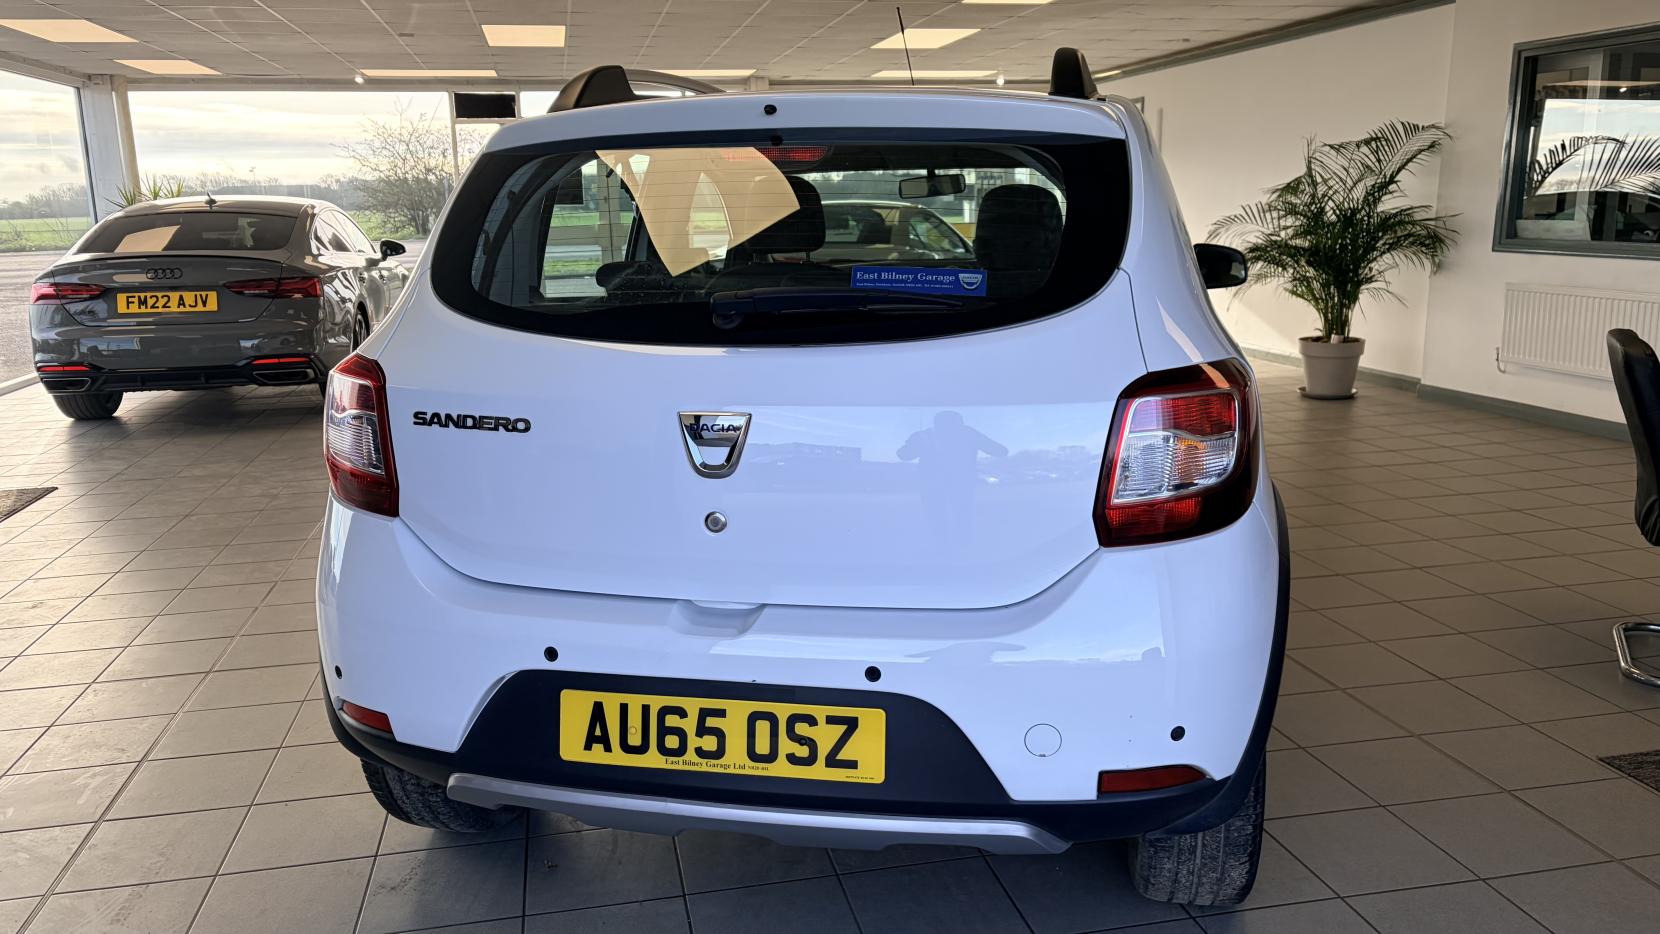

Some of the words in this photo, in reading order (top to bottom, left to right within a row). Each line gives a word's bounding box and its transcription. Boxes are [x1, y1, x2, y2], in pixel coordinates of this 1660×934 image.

[856, 271, 878, 280] East
[880, 272, 915, 282] Bilney
[917, 273, 956, 283] Garage
[126, 294, 171, 310] FM22
[176, 293, 209, 309] AJV
[413, 411, 532, 434] SANDERO
[689, 423, 737, 433] DACIA
[583, 700, 727, 760] AU65
[746, 710, 860, 770] OSZ
[665, 758, 680, 766] East
[682, 759, 703, 768] Bilney
[705, 761, 732, 770] Garage
